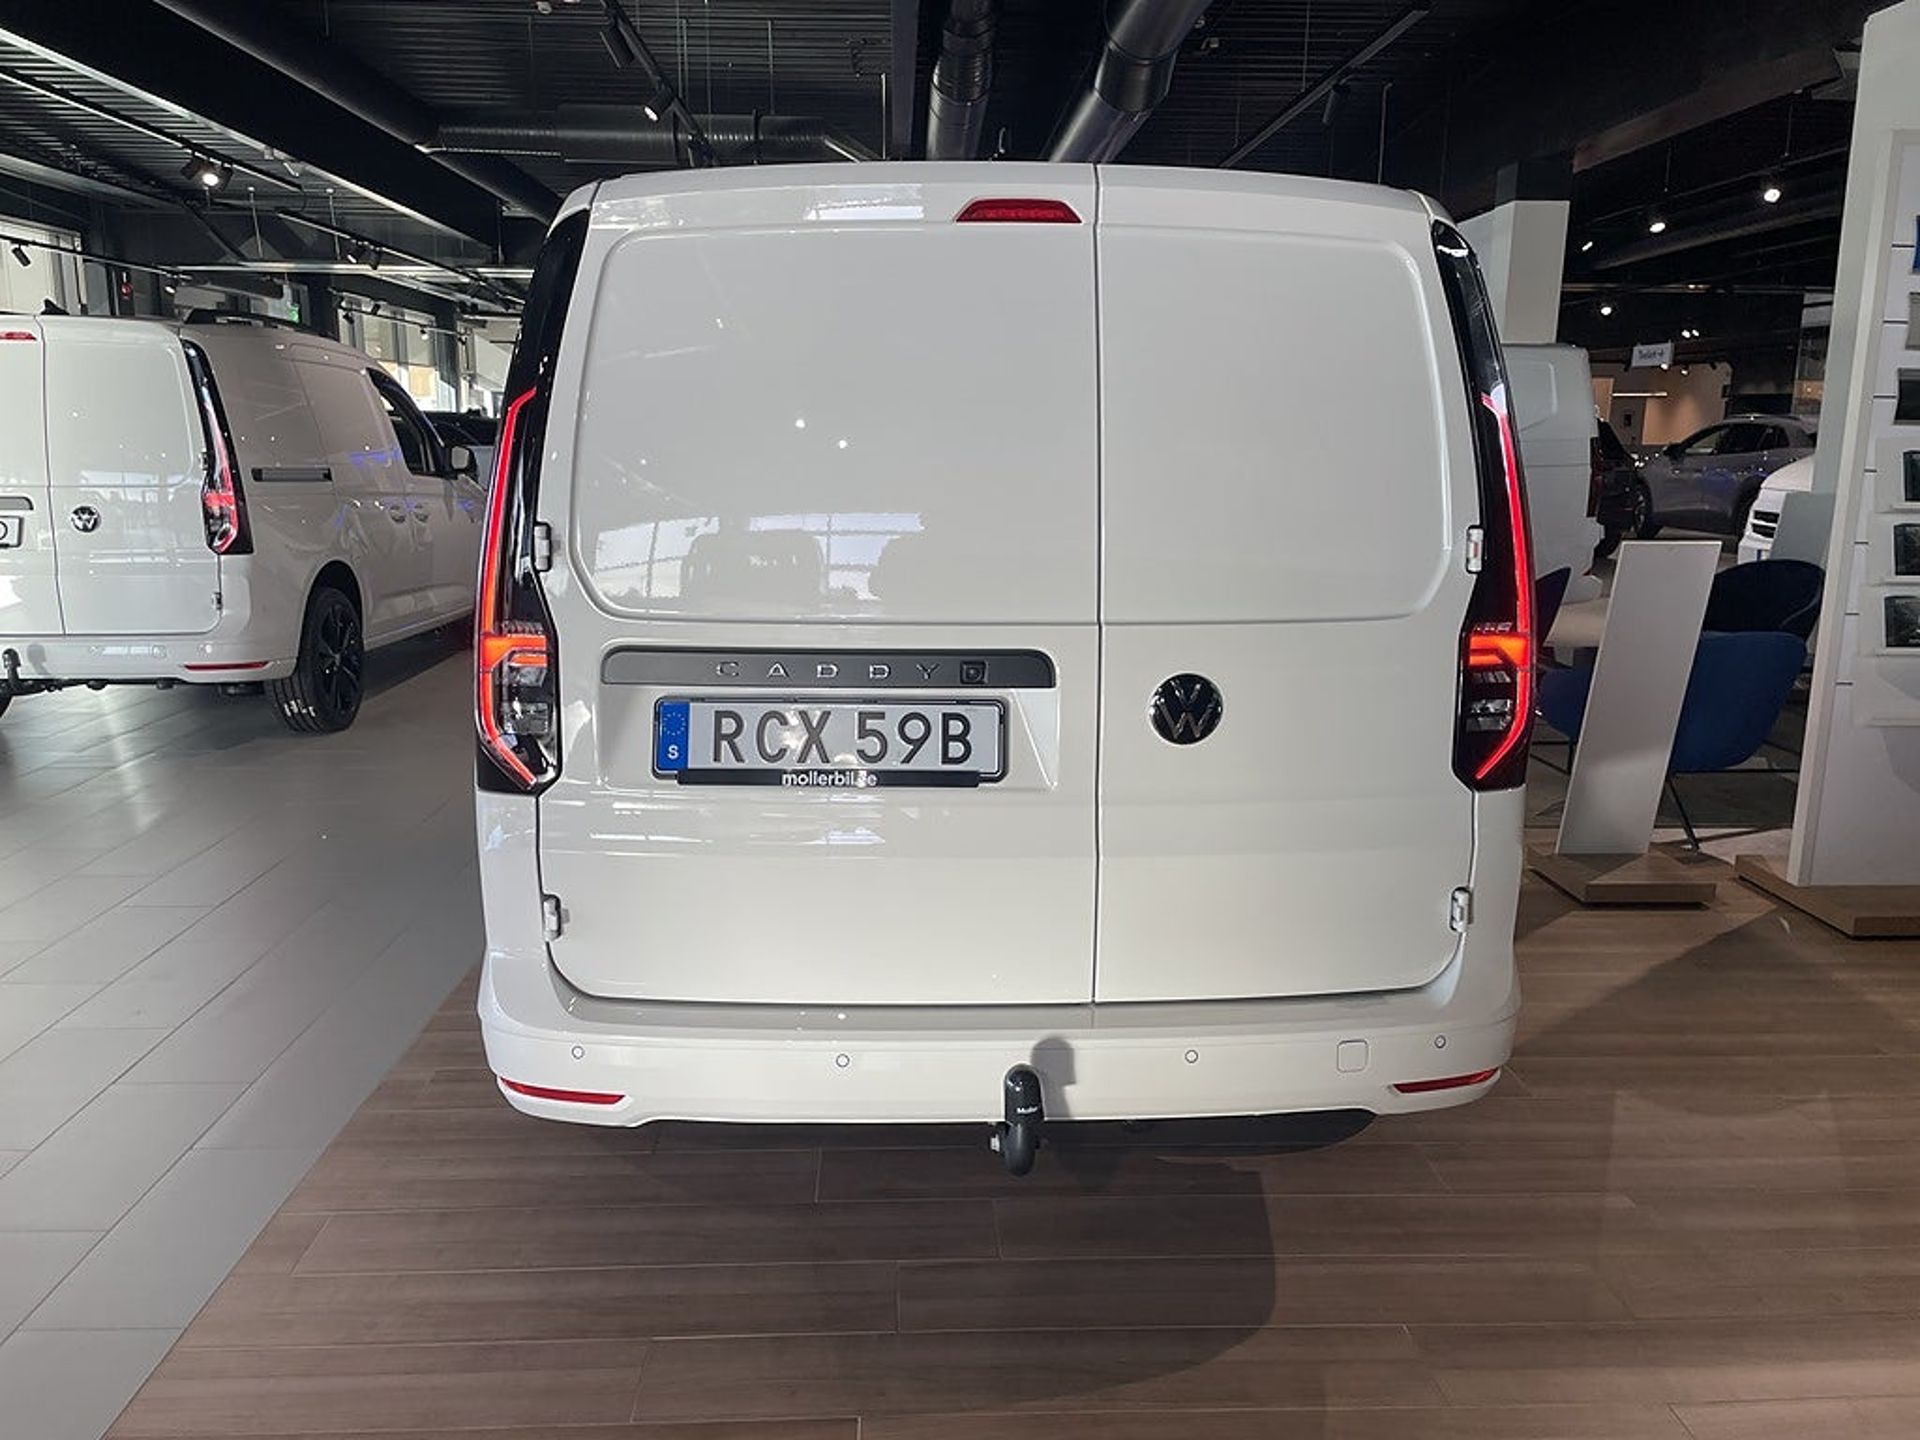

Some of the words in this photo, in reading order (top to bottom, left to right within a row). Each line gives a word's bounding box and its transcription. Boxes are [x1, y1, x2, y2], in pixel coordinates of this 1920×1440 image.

[716, 661, 941, 680] CADDY
[713, 710, 830, 764] RCX
[856, 711, 973, 765] 59B
[668, 744, 679, 760] S
[781, 770, 878, 787] mollerbile
